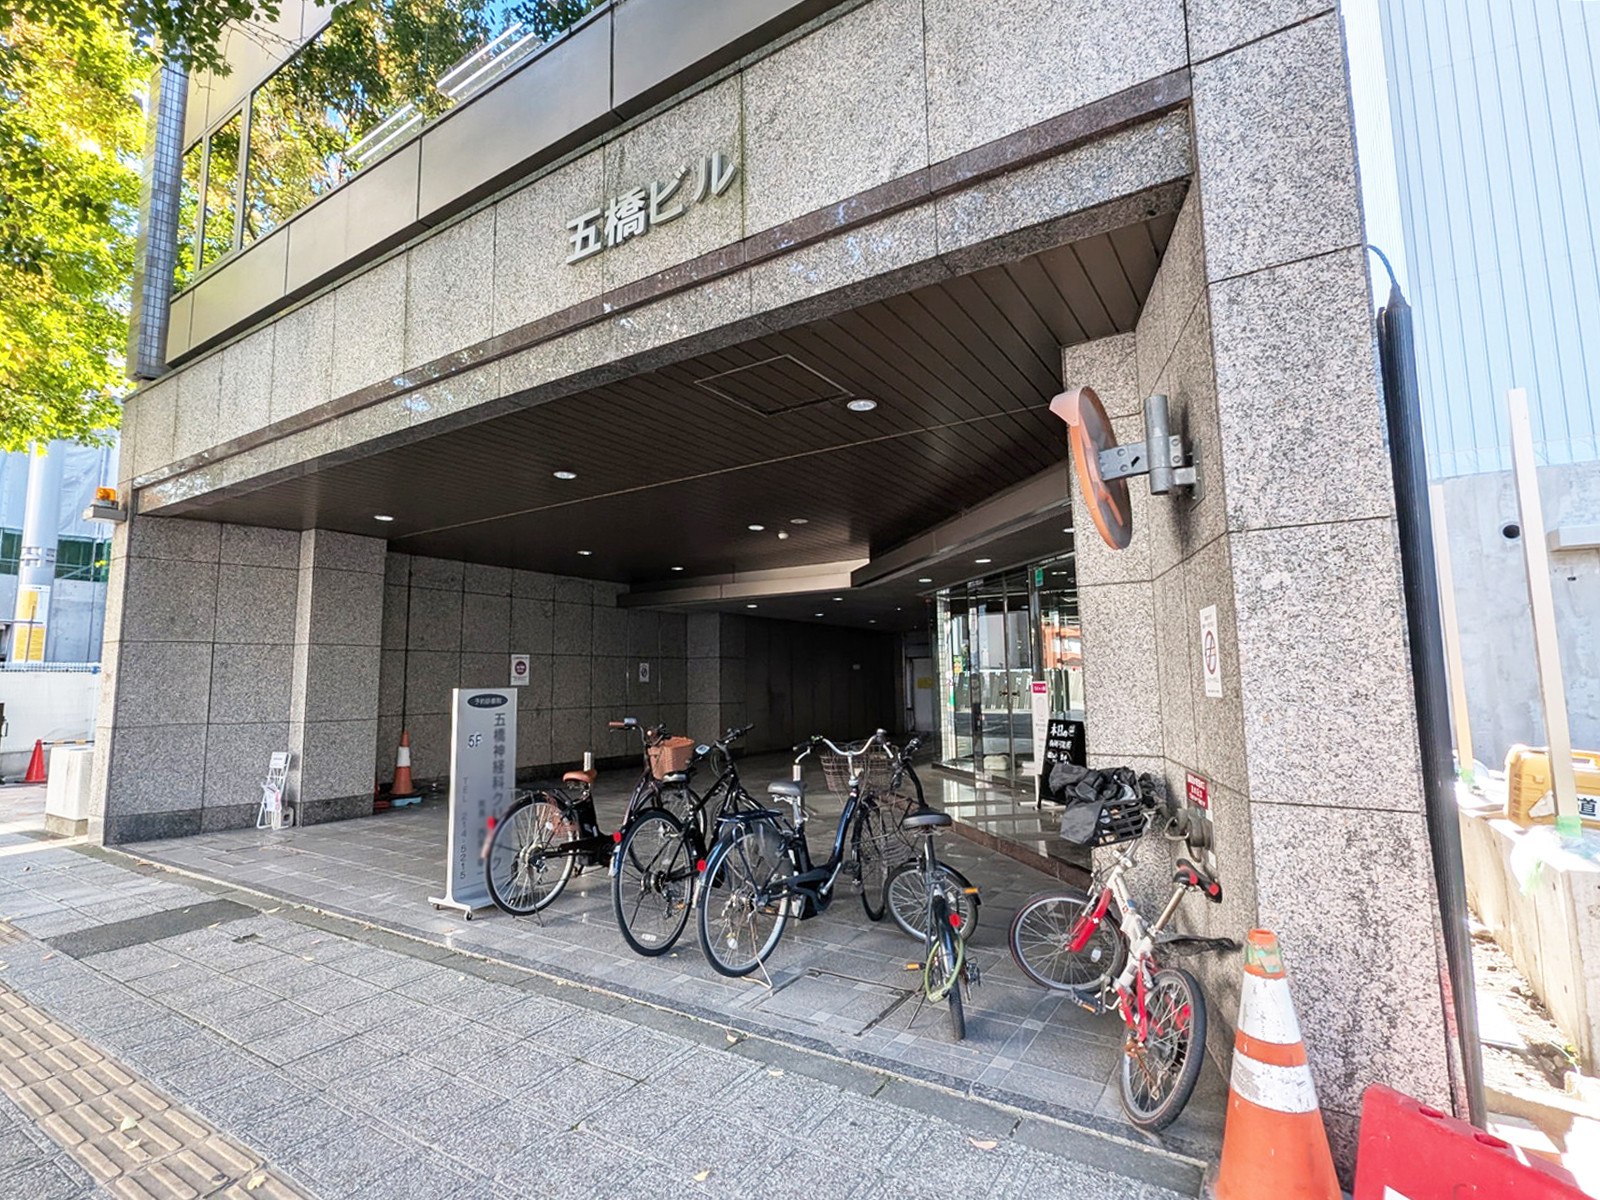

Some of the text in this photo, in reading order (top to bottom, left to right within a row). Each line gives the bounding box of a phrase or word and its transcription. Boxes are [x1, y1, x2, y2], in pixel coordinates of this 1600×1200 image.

[566, 151, 737, 265] 五橋ビル
[467, 734, 482, 748] 5F
